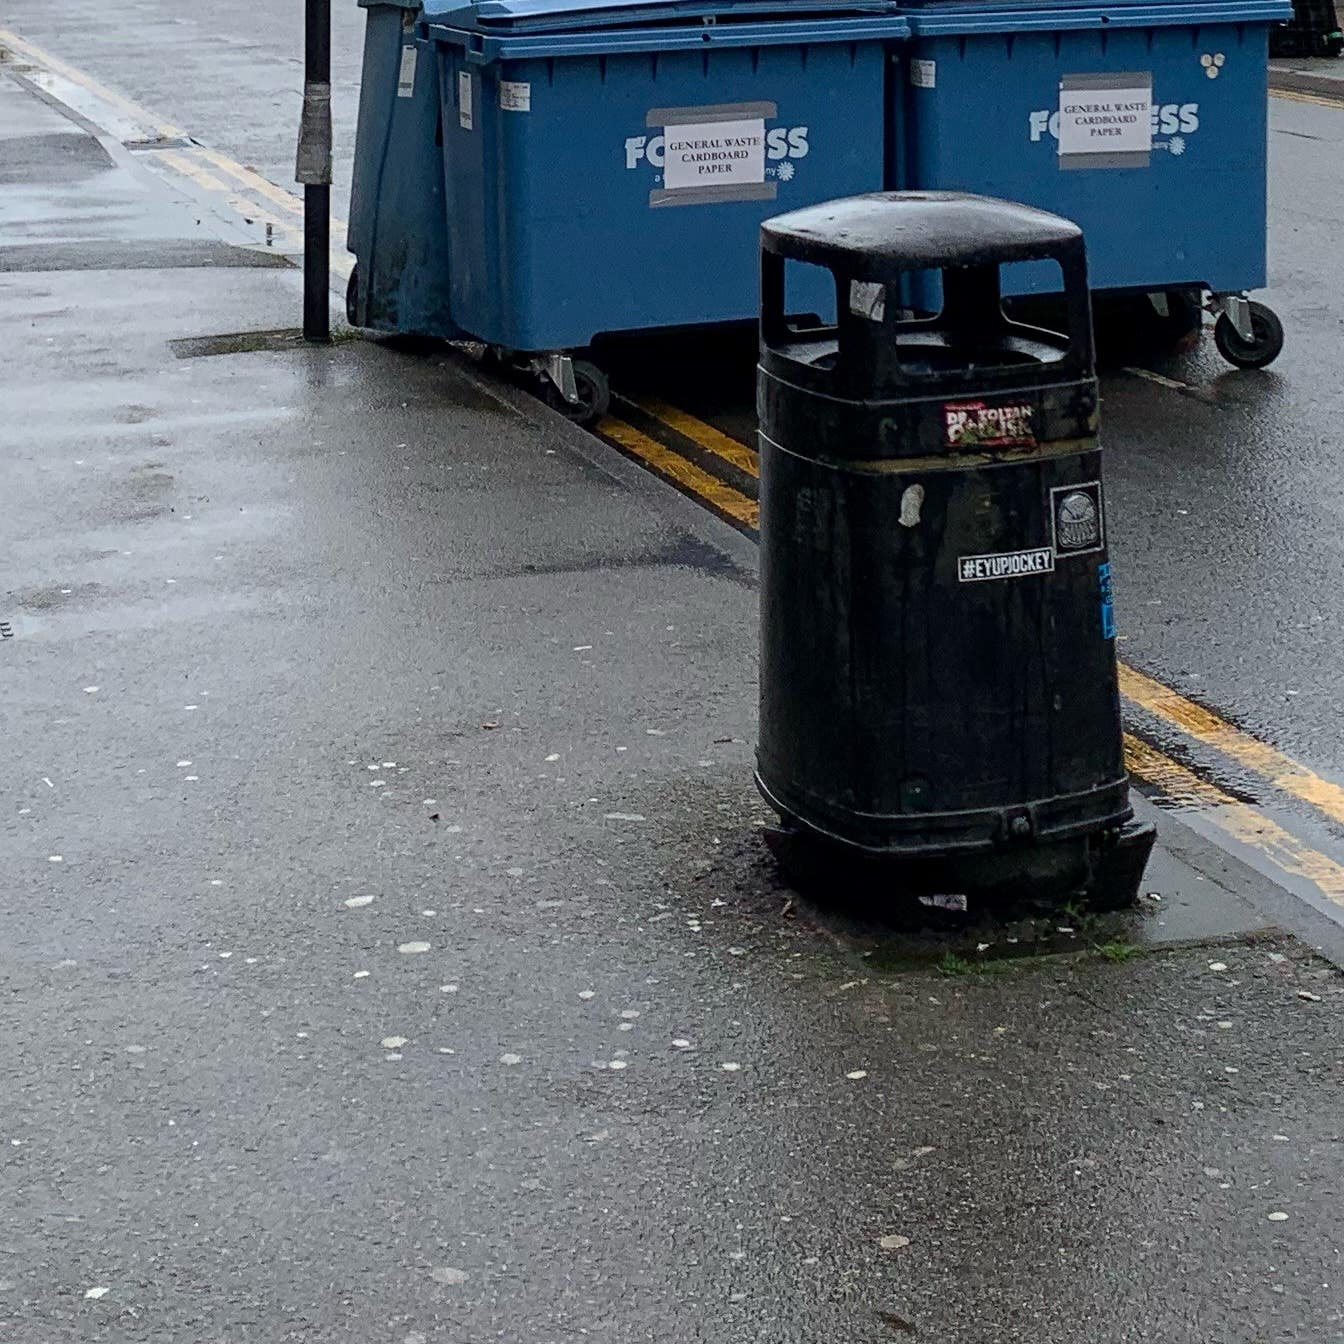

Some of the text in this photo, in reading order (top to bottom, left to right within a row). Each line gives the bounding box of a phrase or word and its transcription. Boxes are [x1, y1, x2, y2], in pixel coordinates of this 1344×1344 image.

[1063, 102, 1149, 115] GENERAL WASTE
[1074, 114, 1137, 126] CARDBOARD
[1089, 127, 1123, 138] PAPER
[669, 136, 762, 152] GENERAL WASTE
[681, 149, 750, 163] CARDBOARD
[697, 163, 733, 175] PAPER
[962, 550, 1051, 578] #EYUPJOCKEY
